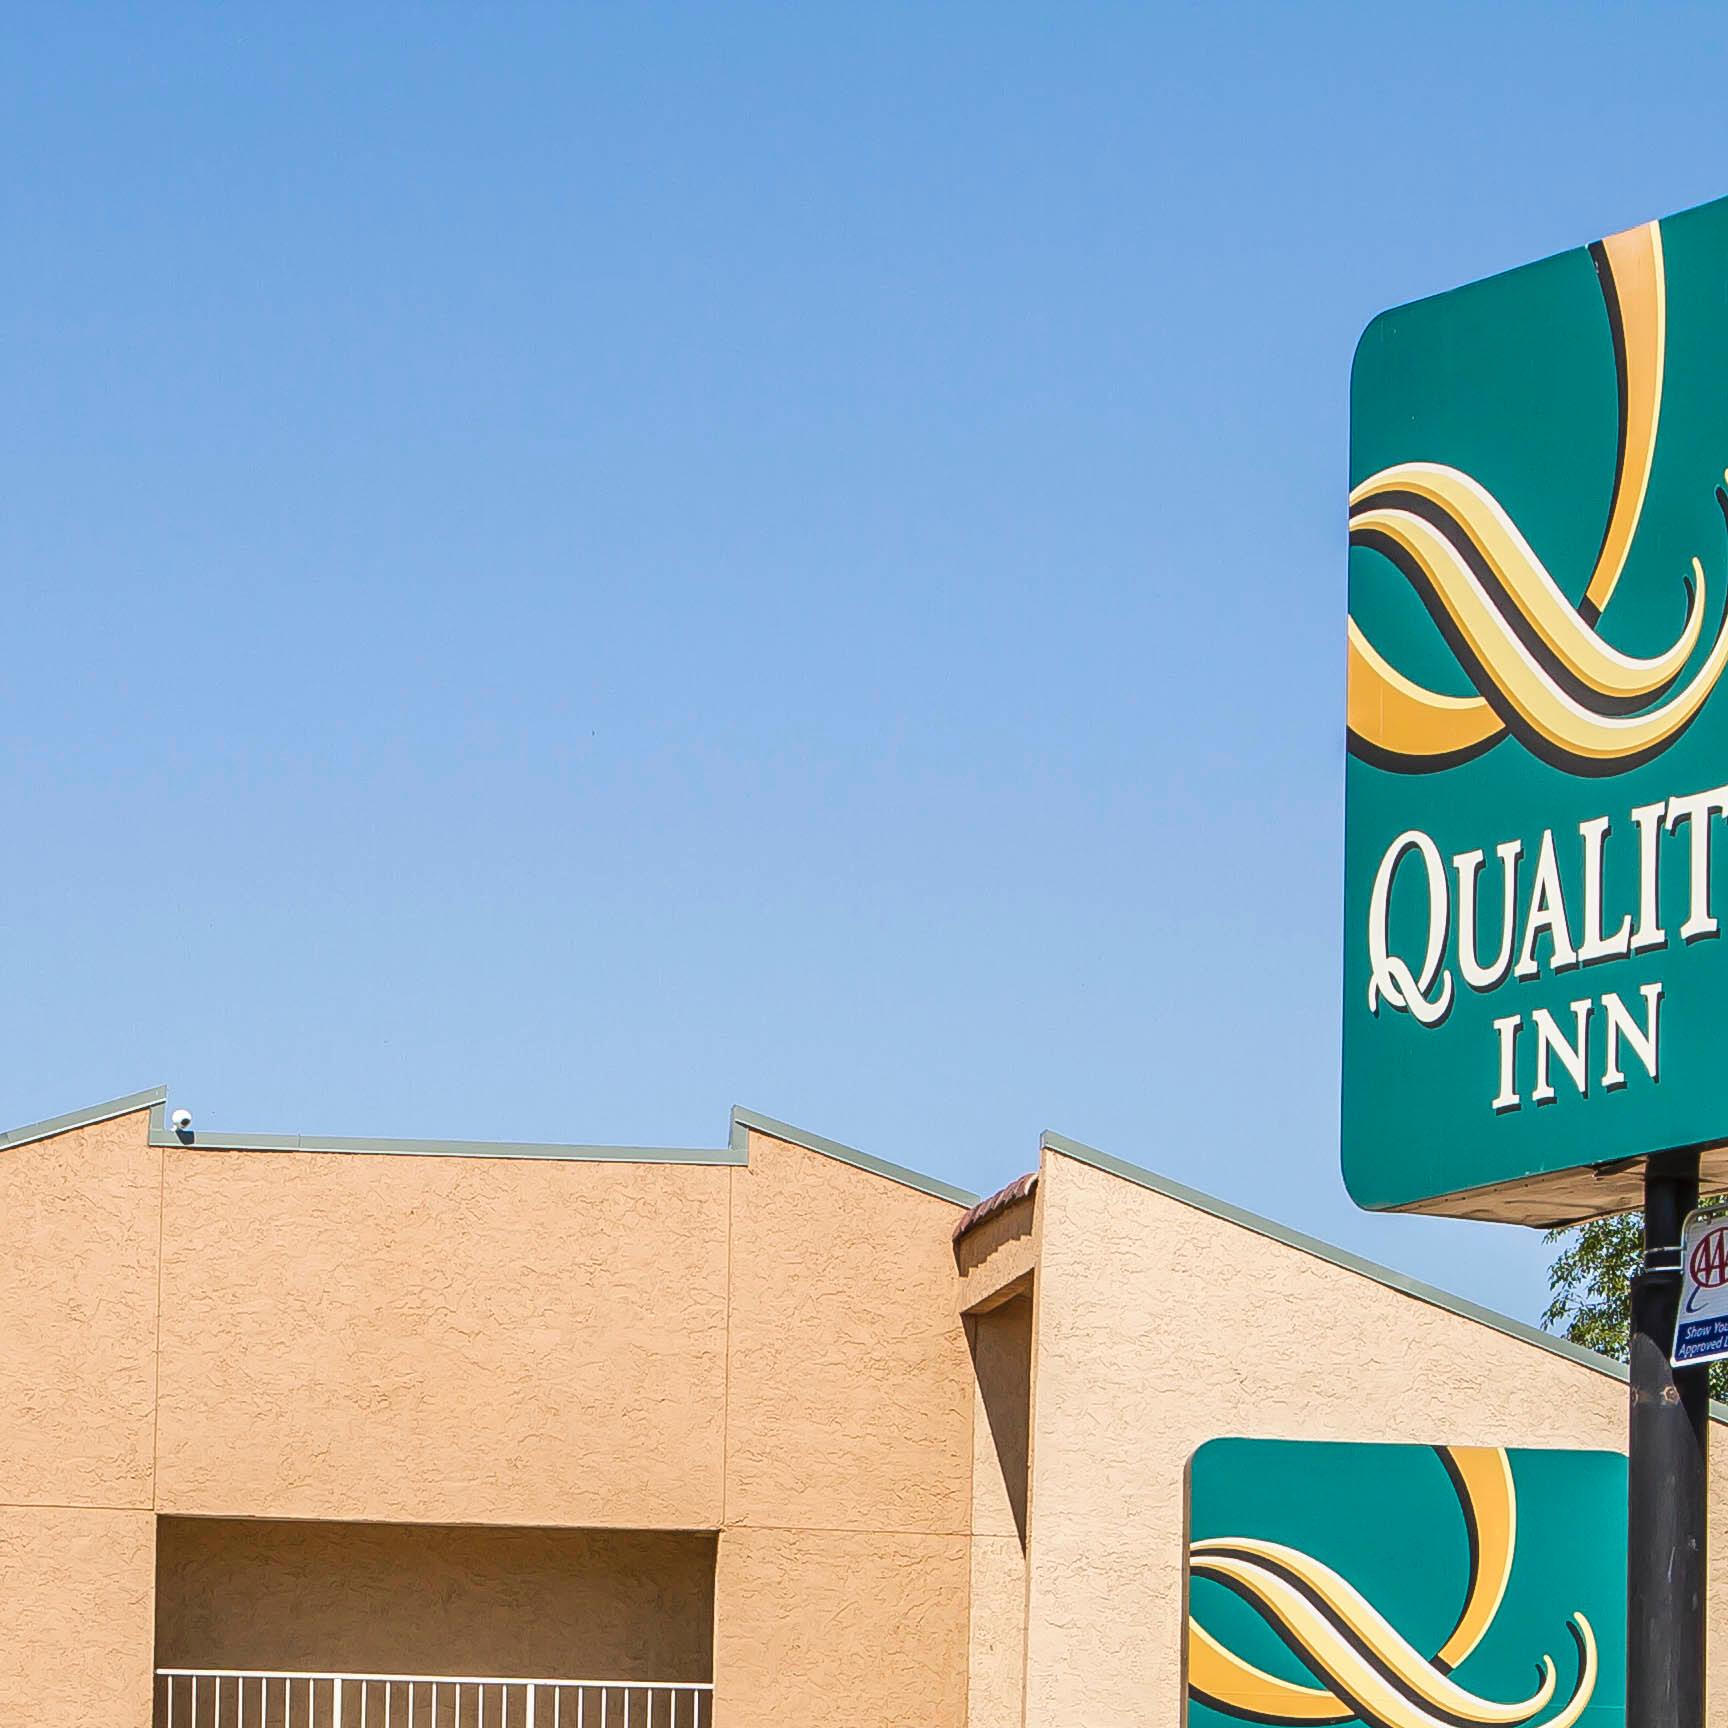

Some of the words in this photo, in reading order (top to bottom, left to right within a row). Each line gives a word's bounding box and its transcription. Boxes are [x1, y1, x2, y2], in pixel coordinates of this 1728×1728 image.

[1491, 982, 1666, 1114] INN
[1685, 1326, 1712, 1340] Show
[1678, 1336, 1723, 1358] Approved
